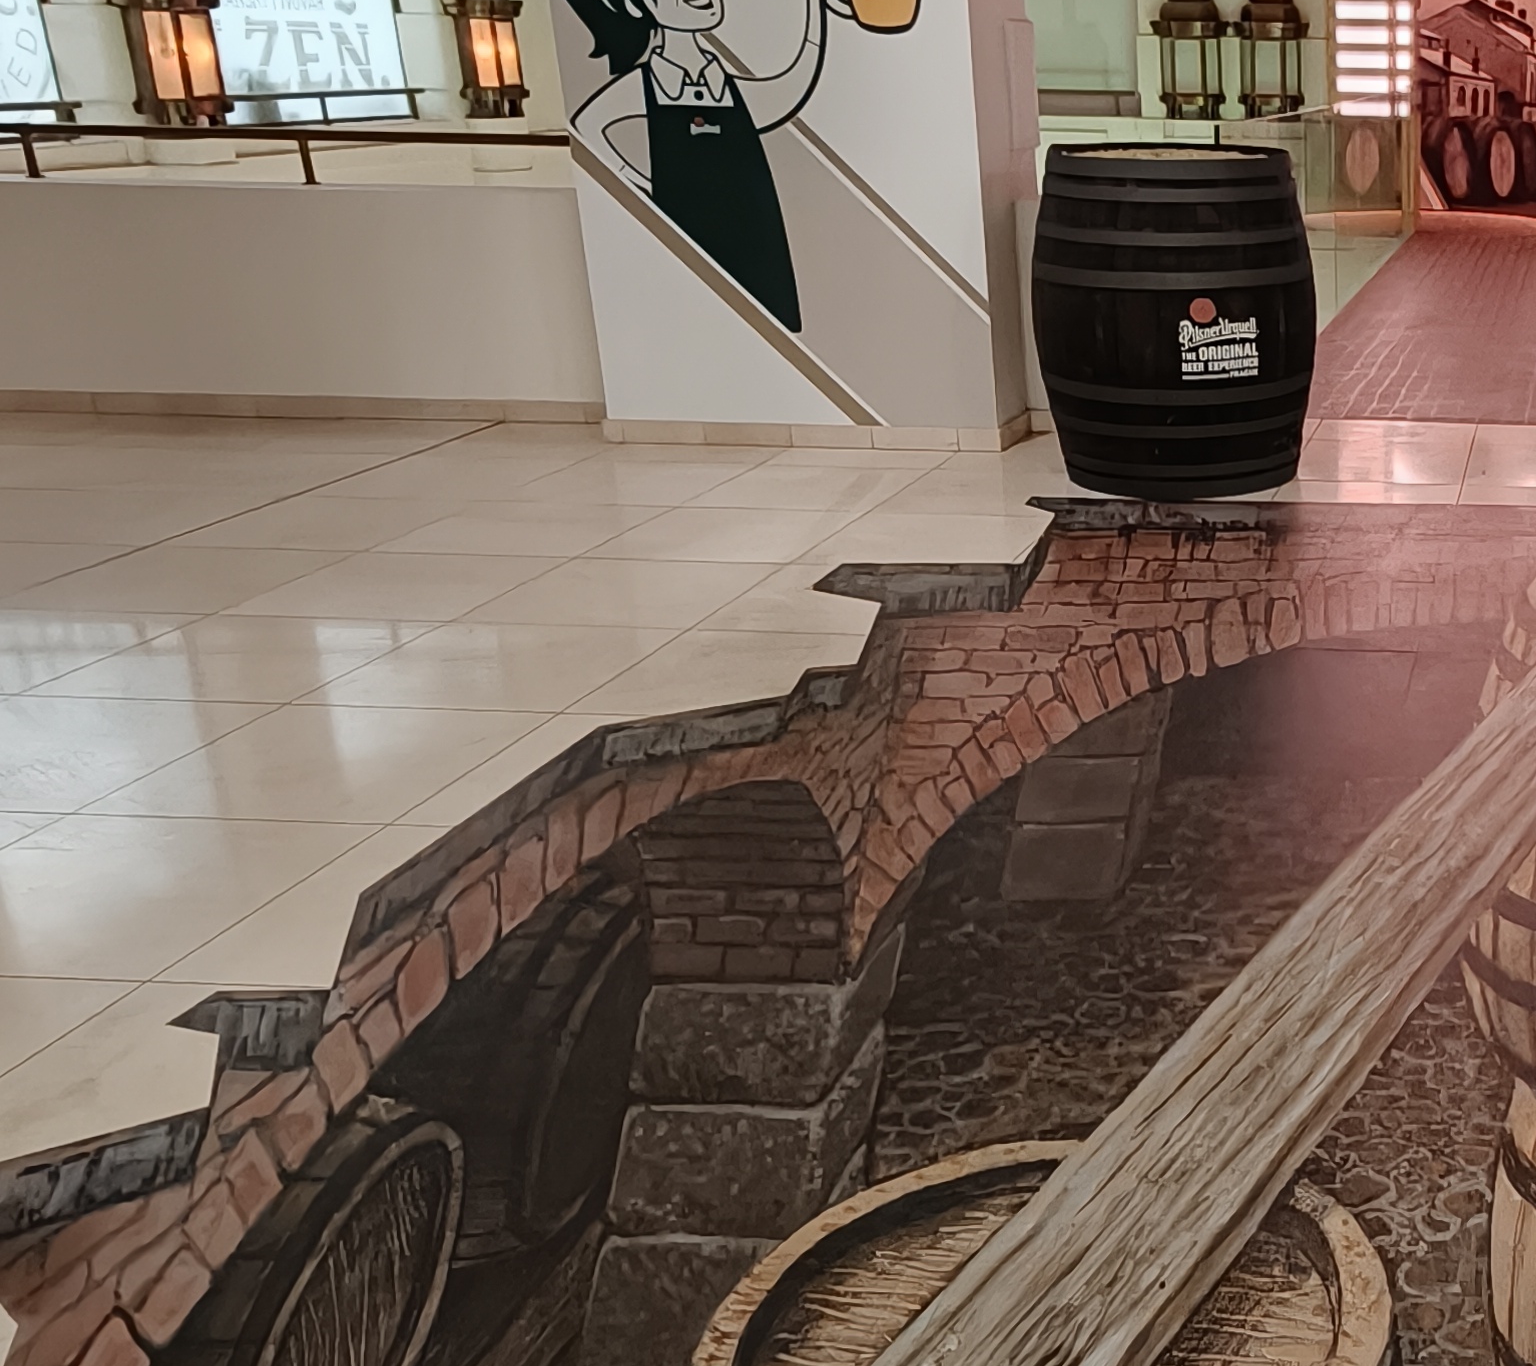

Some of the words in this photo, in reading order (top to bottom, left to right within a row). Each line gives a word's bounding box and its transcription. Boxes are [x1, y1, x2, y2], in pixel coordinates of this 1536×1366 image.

[1178, 319, 1221, 351] Pilsner
[1218, 316, 1257, 340] Urquell
[1198, 342, 1259, 361] ORIGINAL
